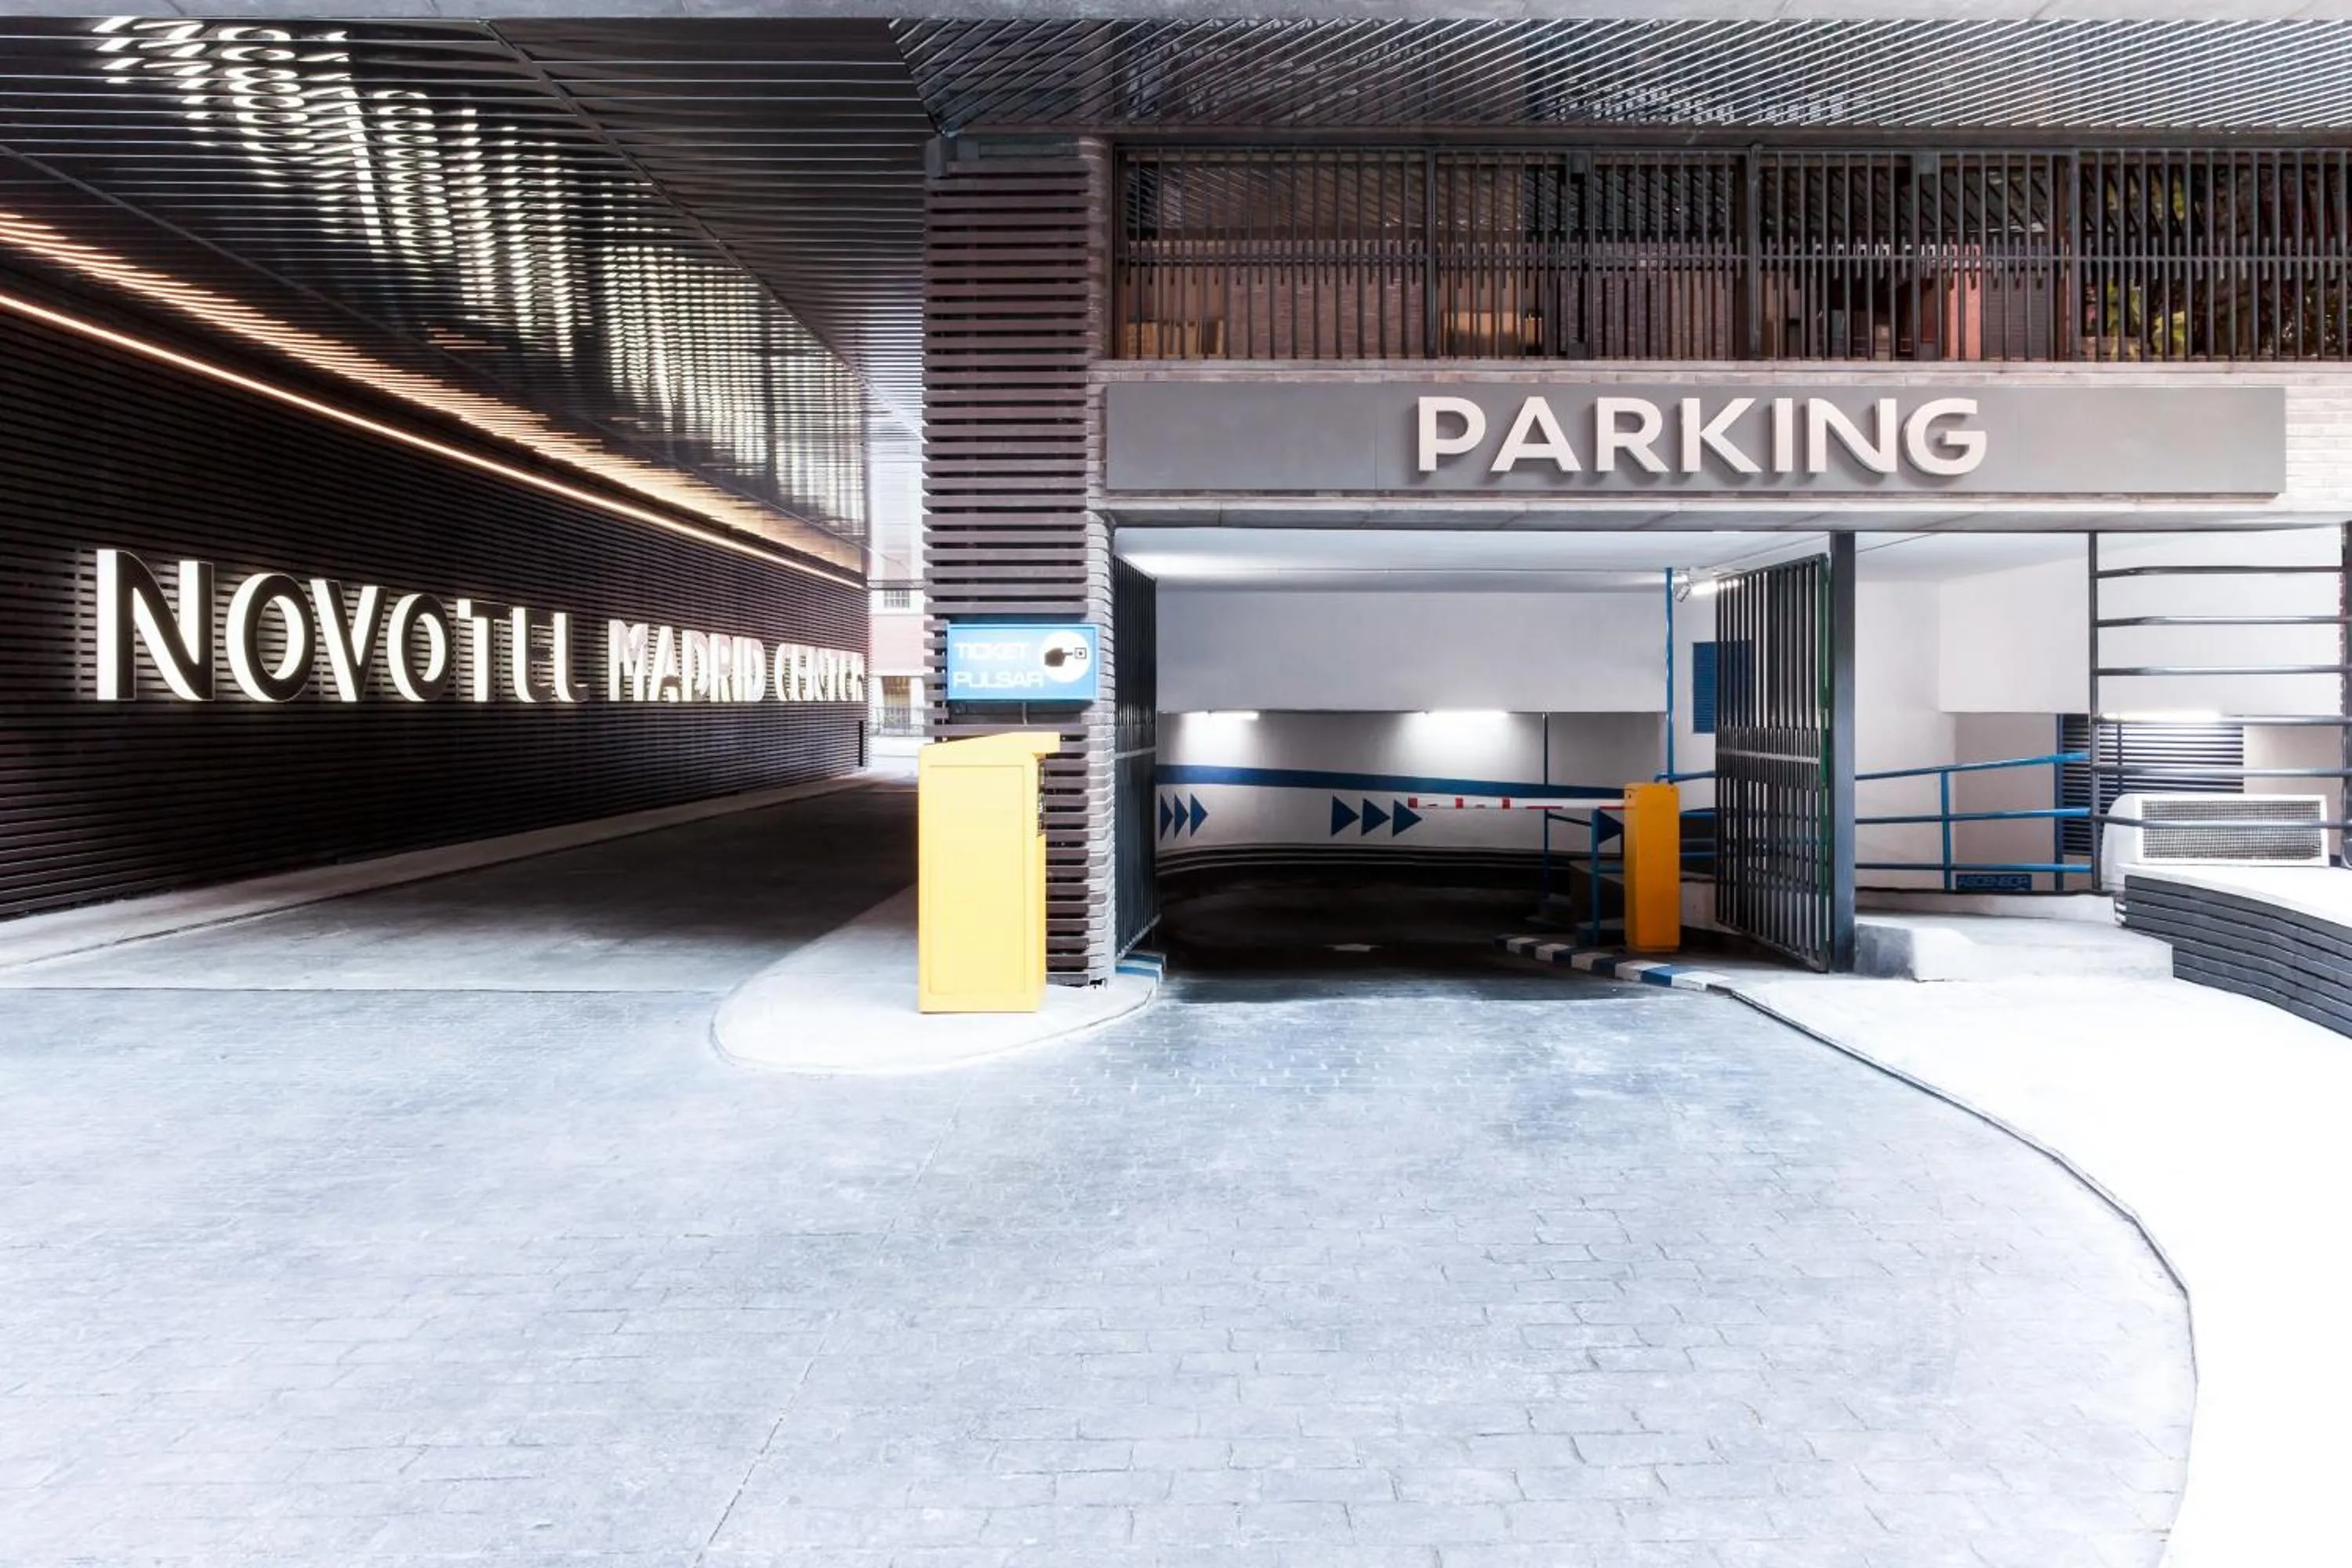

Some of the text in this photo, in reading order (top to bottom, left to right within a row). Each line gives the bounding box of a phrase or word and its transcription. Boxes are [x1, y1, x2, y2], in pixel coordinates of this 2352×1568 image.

[1417, 396, 1987, 476] PARKING
[96, 548, 590, 702] NOVOTEL
[608, 619, 767, 702] MADRID
[954, 642, 1029, 660] TICKET
[953, 671, 1044, 688] PULSAR
